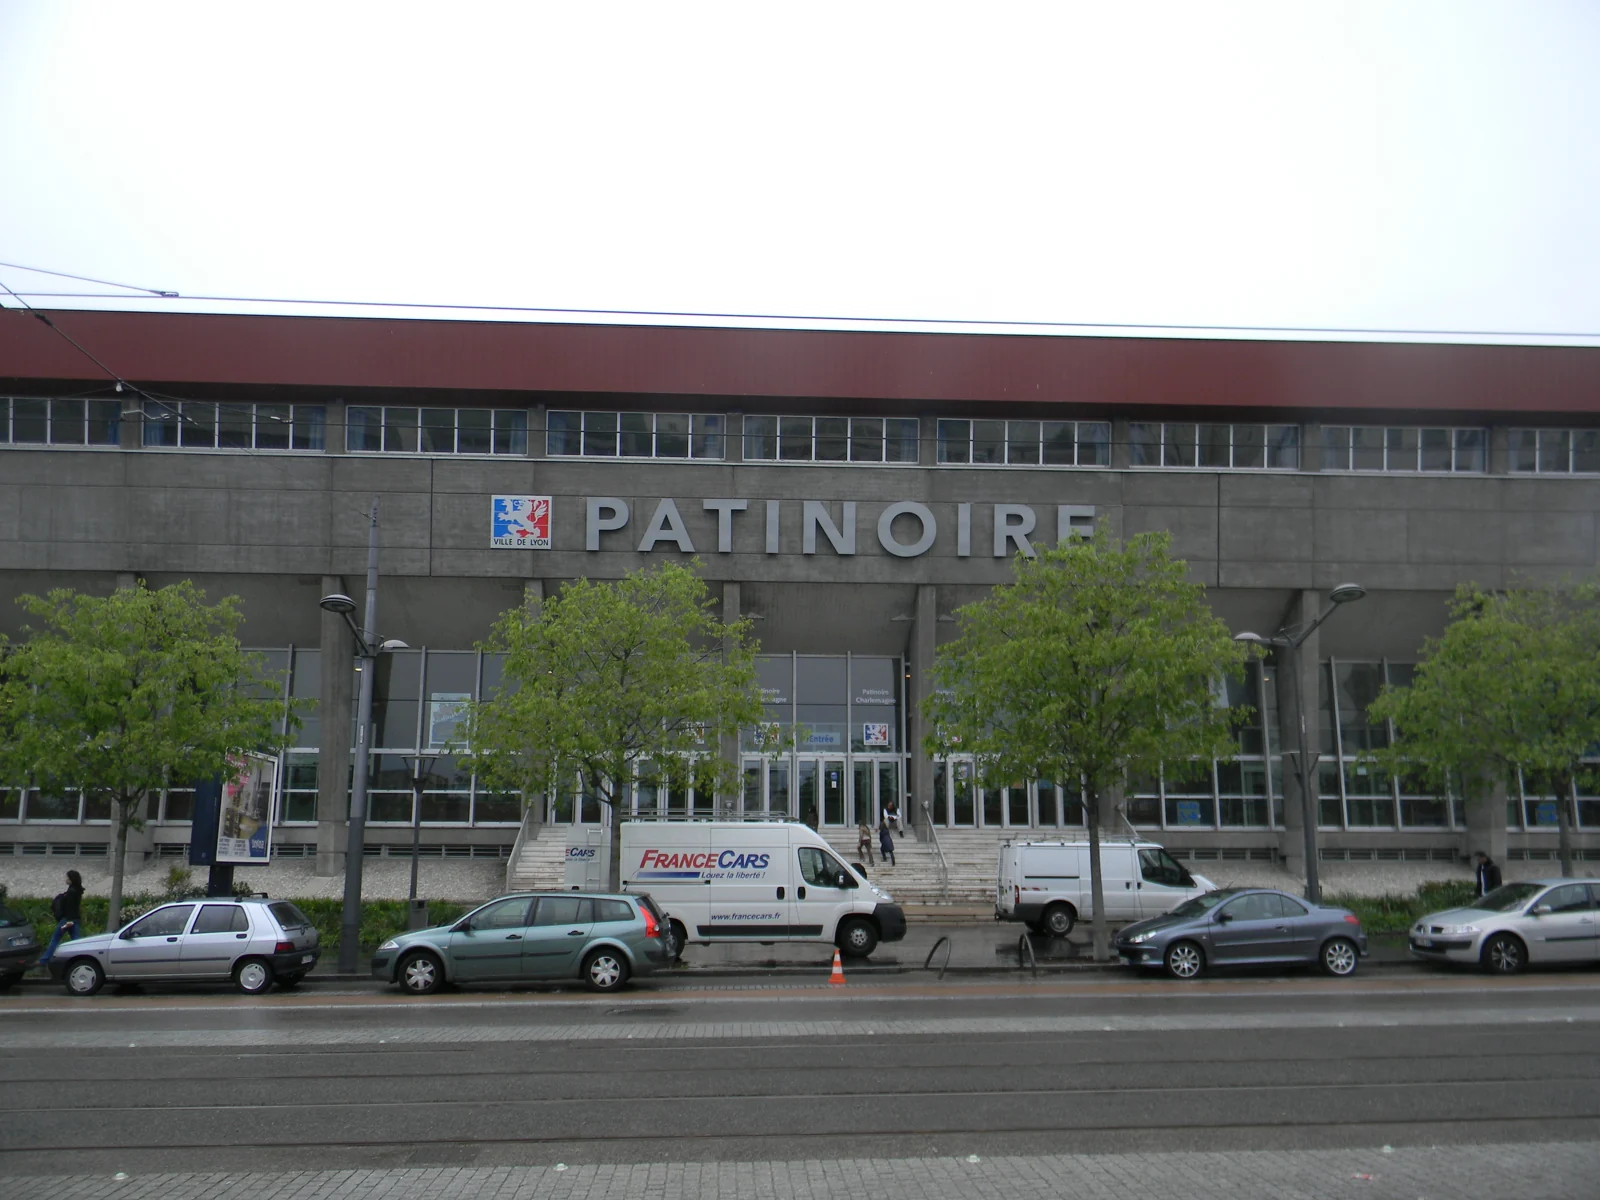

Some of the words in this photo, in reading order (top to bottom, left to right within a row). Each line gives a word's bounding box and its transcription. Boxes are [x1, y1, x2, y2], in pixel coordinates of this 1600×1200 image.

[586, 496, 1096, 558] PATINOIRE
[494, 538, 513, 546] VILLE
[855, 696, 896, 705] Charlemagne
[809, 734, 834, 743] Entrée
[711, 912, 781, 921] www.francecars.fr
